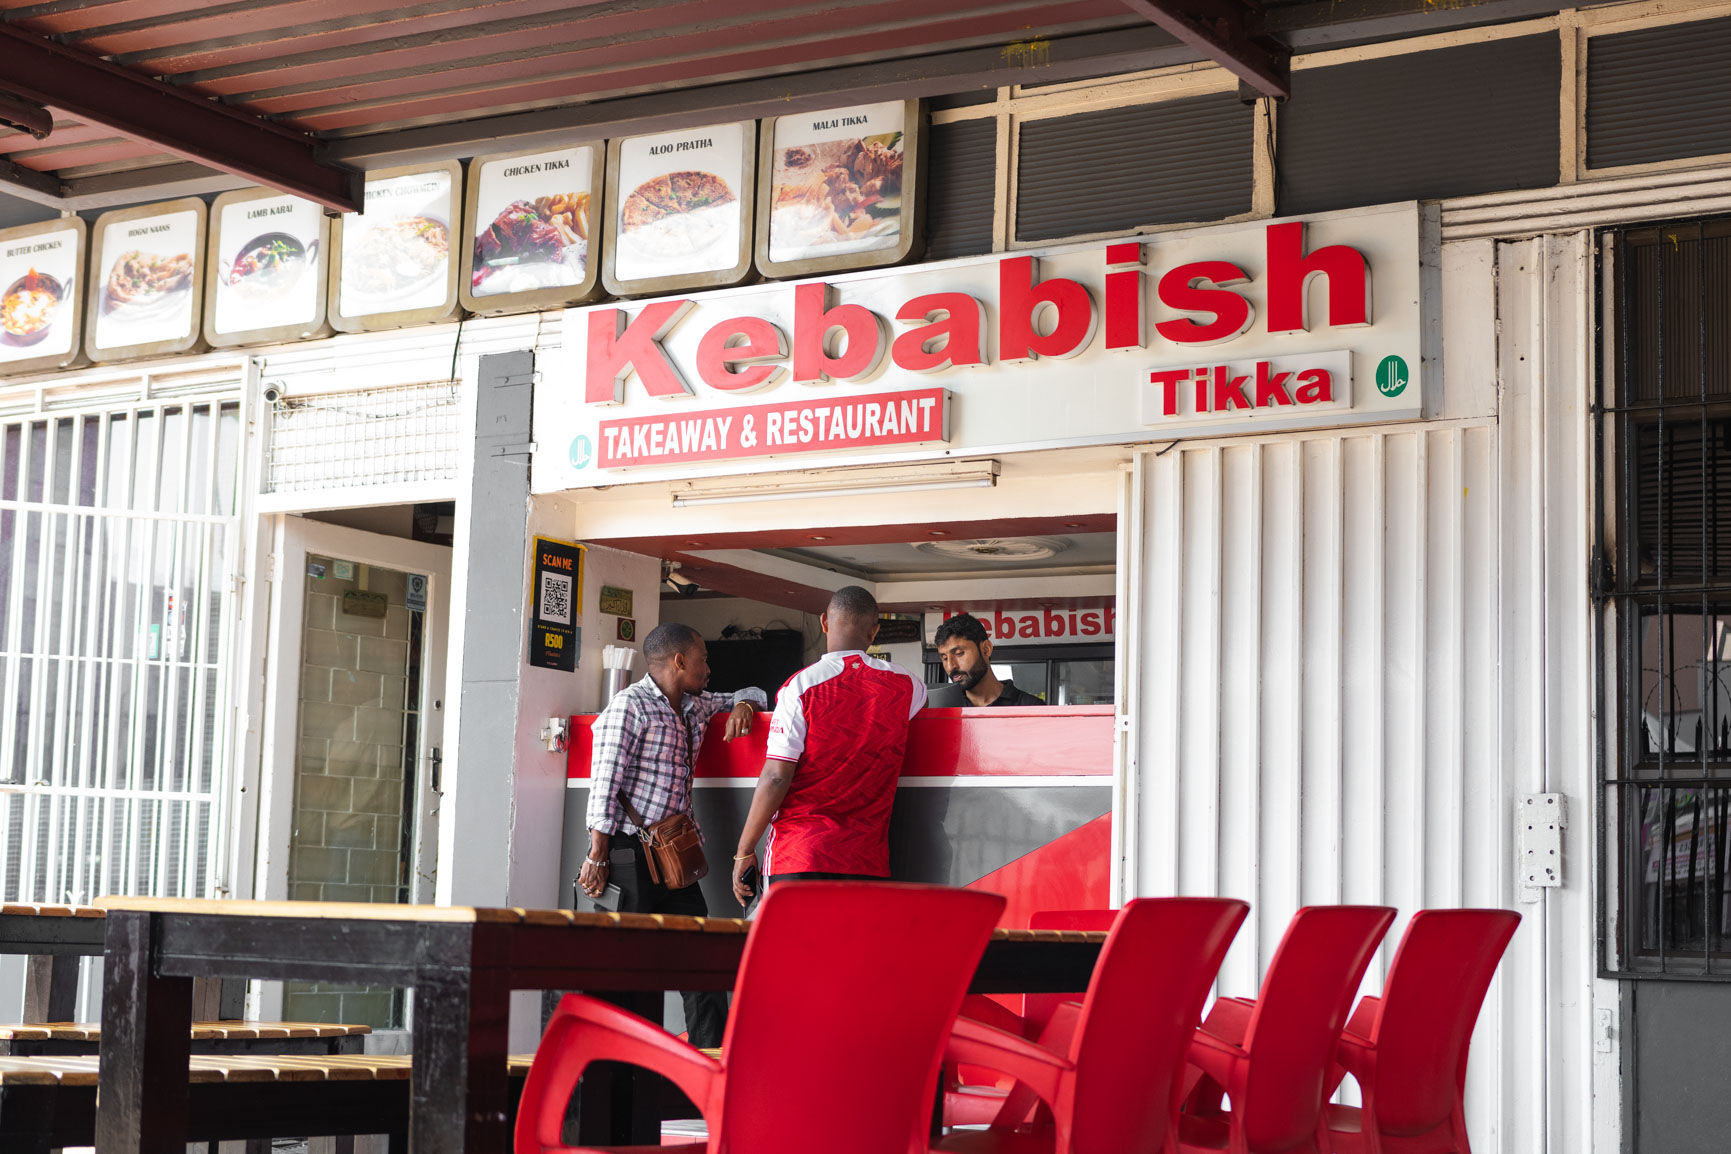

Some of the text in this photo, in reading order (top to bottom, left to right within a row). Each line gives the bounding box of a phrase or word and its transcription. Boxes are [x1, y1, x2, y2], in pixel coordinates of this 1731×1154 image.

[813, 114, 868, 131] MALAI TIKKA
[649, 138, 713, 156] ALOO PRATHA
[503, 159, 570, 177] CHICKEN TIKKA
[247, 204, 293, 219] LAMB KARAI
[6, 240, 62, 258] BUTTER CHICKEN
[585, 221, 1368, 404] Kebabish
[1150, 361, 1333, 416] Tikka
[604, 397, 936, 460] TAKEAWAY & RESTAURANT
[542, 553, 573, 571] SCAN ME
[545, 632, 564, 649] R500
